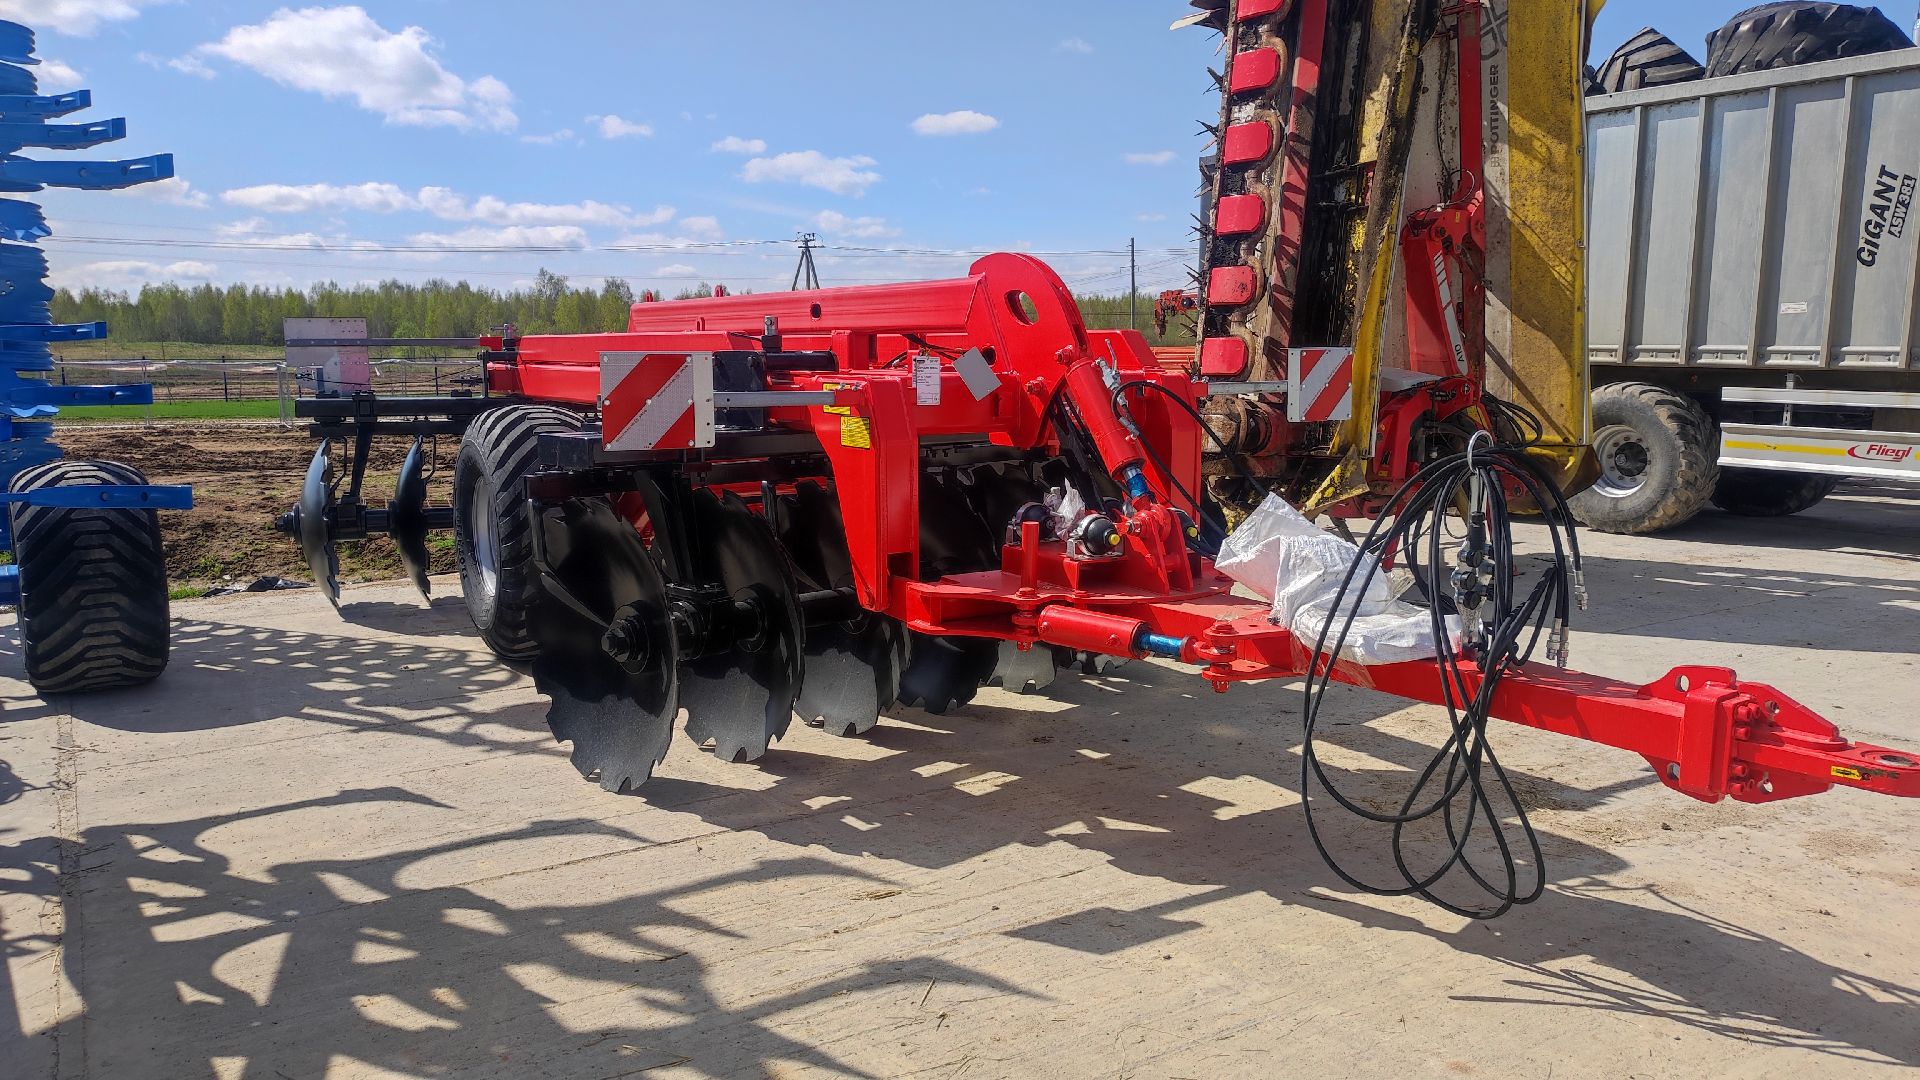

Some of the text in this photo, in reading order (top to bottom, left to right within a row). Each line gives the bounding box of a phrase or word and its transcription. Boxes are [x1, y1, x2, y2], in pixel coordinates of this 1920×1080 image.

[1857, 164, 1899, 267] GIGANT
[1889, 177, 1916, 238] ASW 381
[1866, 443, 1912, 460] Fliegl
